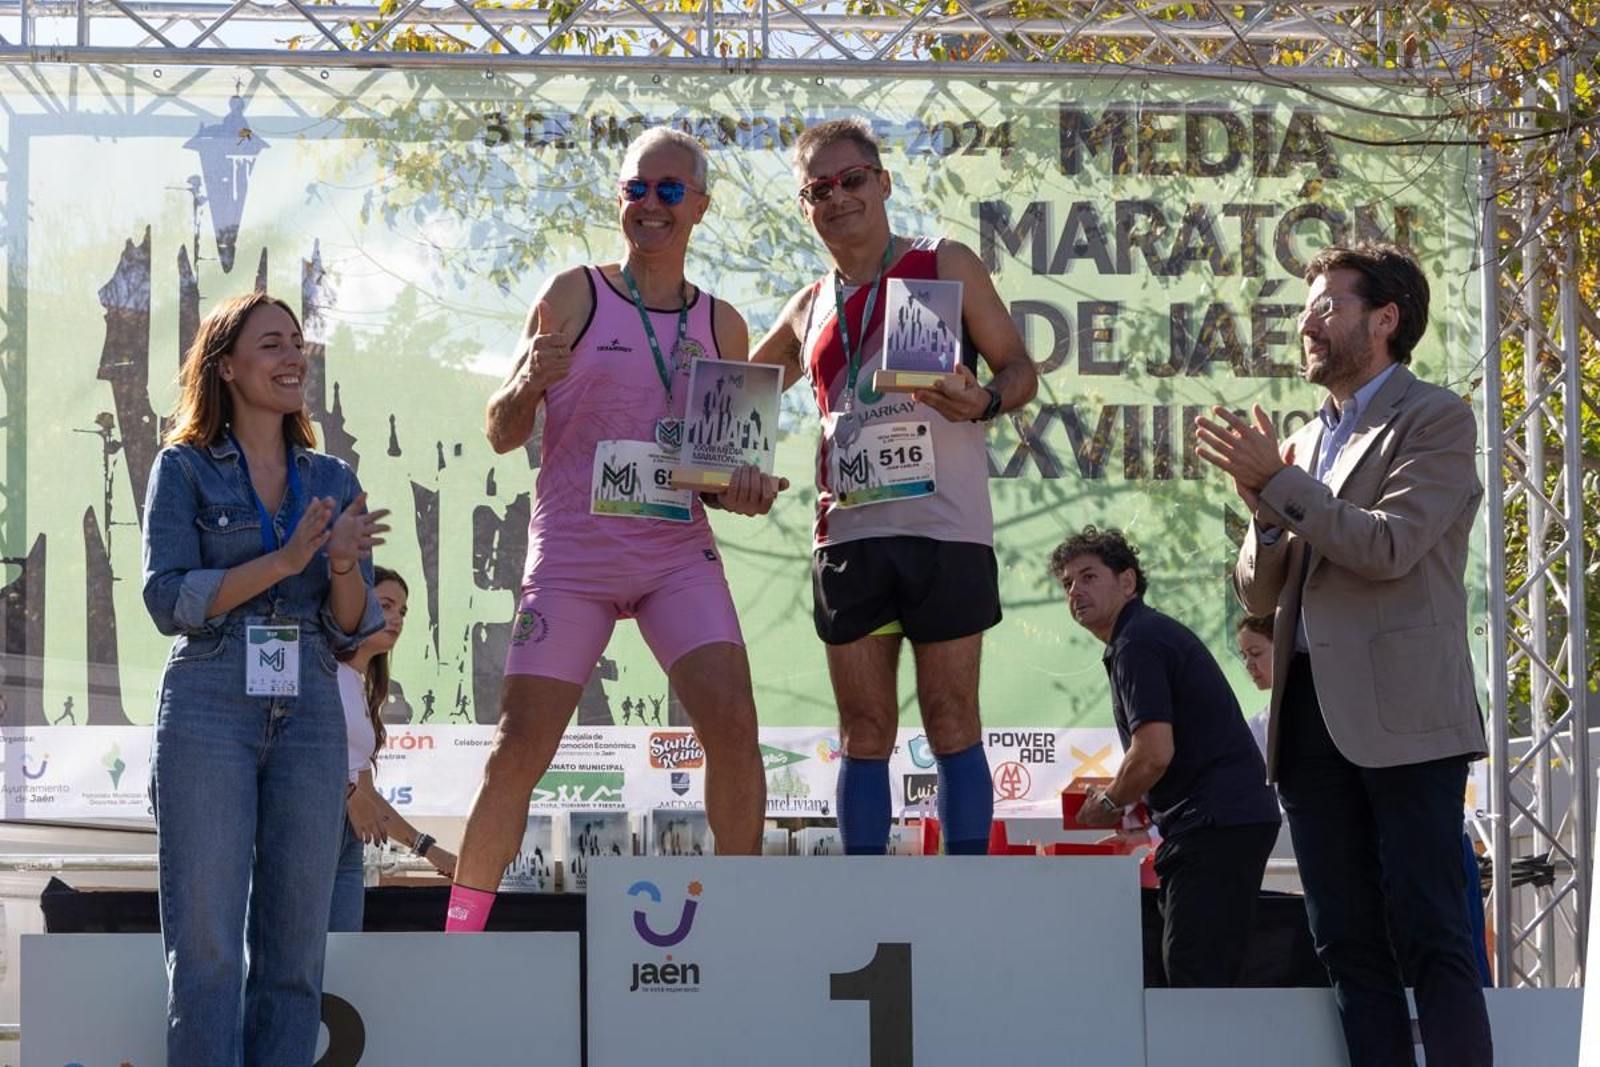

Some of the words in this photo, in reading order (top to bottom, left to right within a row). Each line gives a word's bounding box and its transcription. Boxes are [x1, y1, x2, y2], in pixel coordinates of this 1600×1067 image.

[904, 120, 1015, 156] 2024
[1060, 101, 1340, 179] MEDIA
[1010, 299, 1126, 377] DE
[1145, 279, 1303, 379] JAÉ
[986, 404, 1205, 480] XVIII
[879, 445, 923, 466] 516
[384, 731, 434, 750] rón
[563, 733, 592, 742] ncejalía
[650, 732, 700, 756] Santo
[988, 732, 1056, 748] POWER
[658, 748, 704, 769] Reino
[1019, 749, 1056, 764] ADE
[1, 783, 70, 795] Ayuntamiento
[30, 793, 54, 803] Jaén
[629, 954, 700, 992] jaén
[829, 942, 913, 1067] 1
